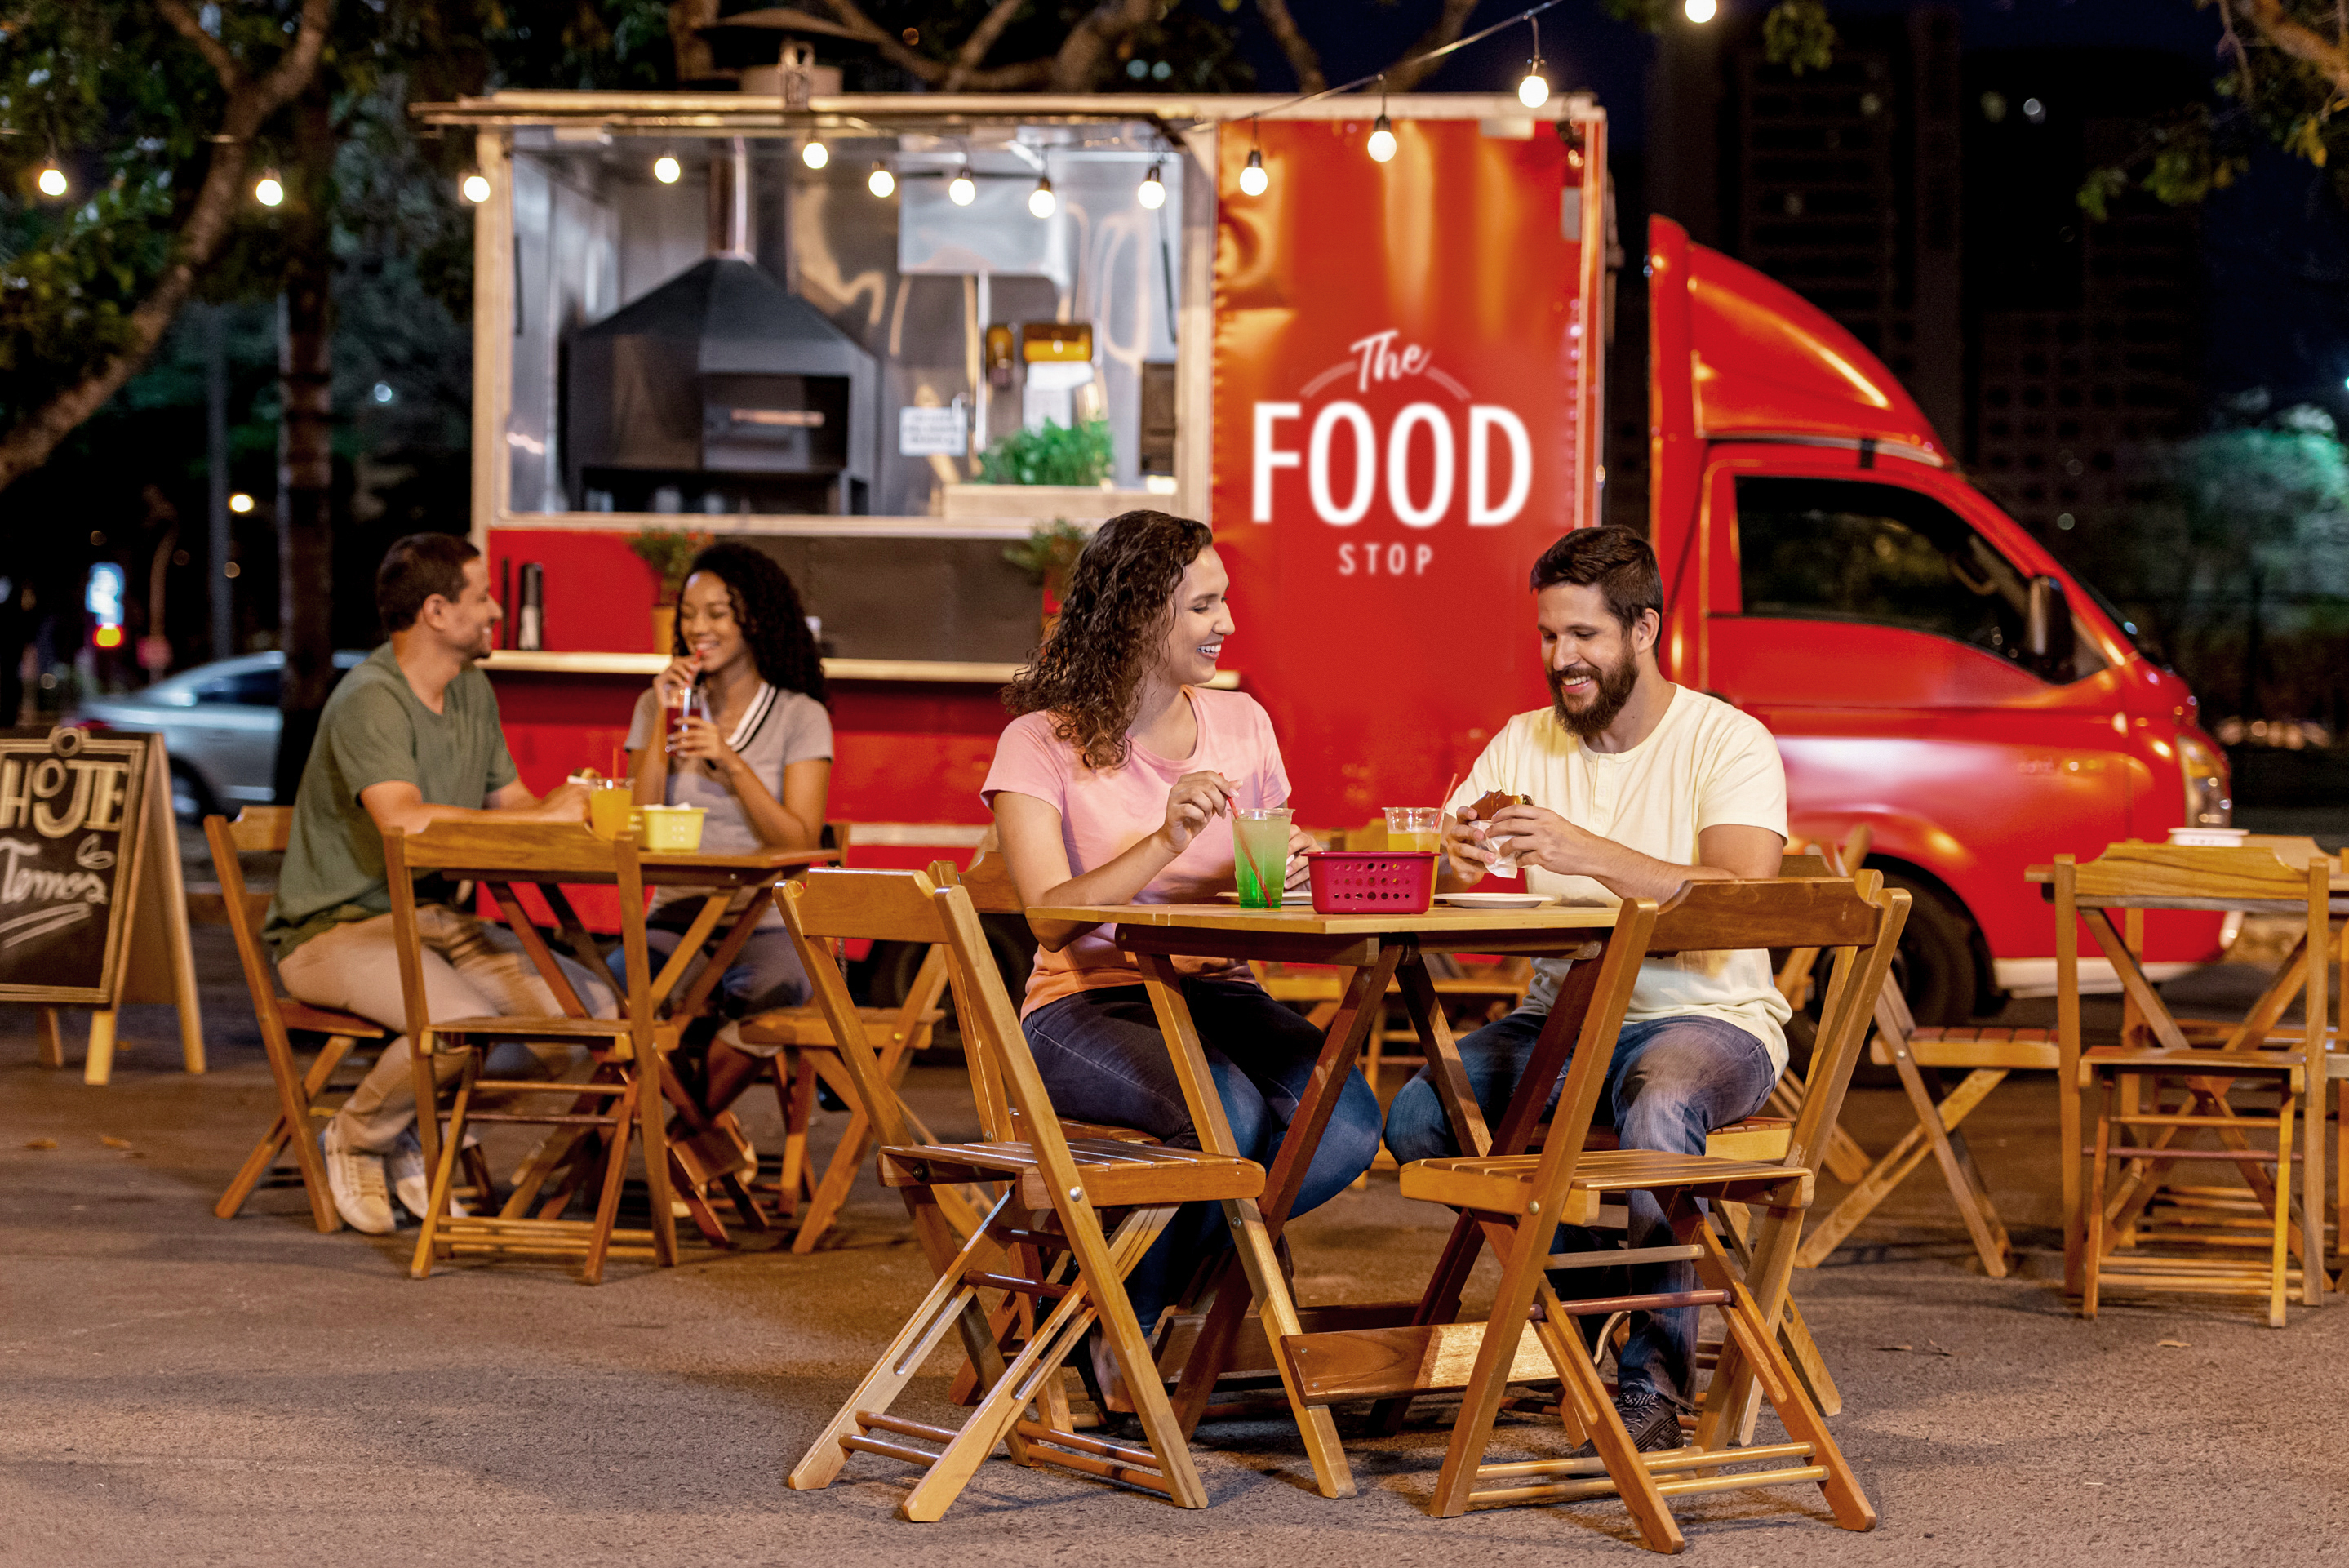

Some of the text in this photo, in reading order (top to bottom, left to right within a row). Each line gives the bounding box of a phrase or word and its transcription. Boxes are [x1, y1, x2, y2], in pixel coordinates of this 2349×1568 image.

[1349, 328, 1432, 393] The
[1252, 400, 1533, 528] FOOD
[1339, 543, 1433, 575] STOP
[0, 758, 130, 839] HOJE
